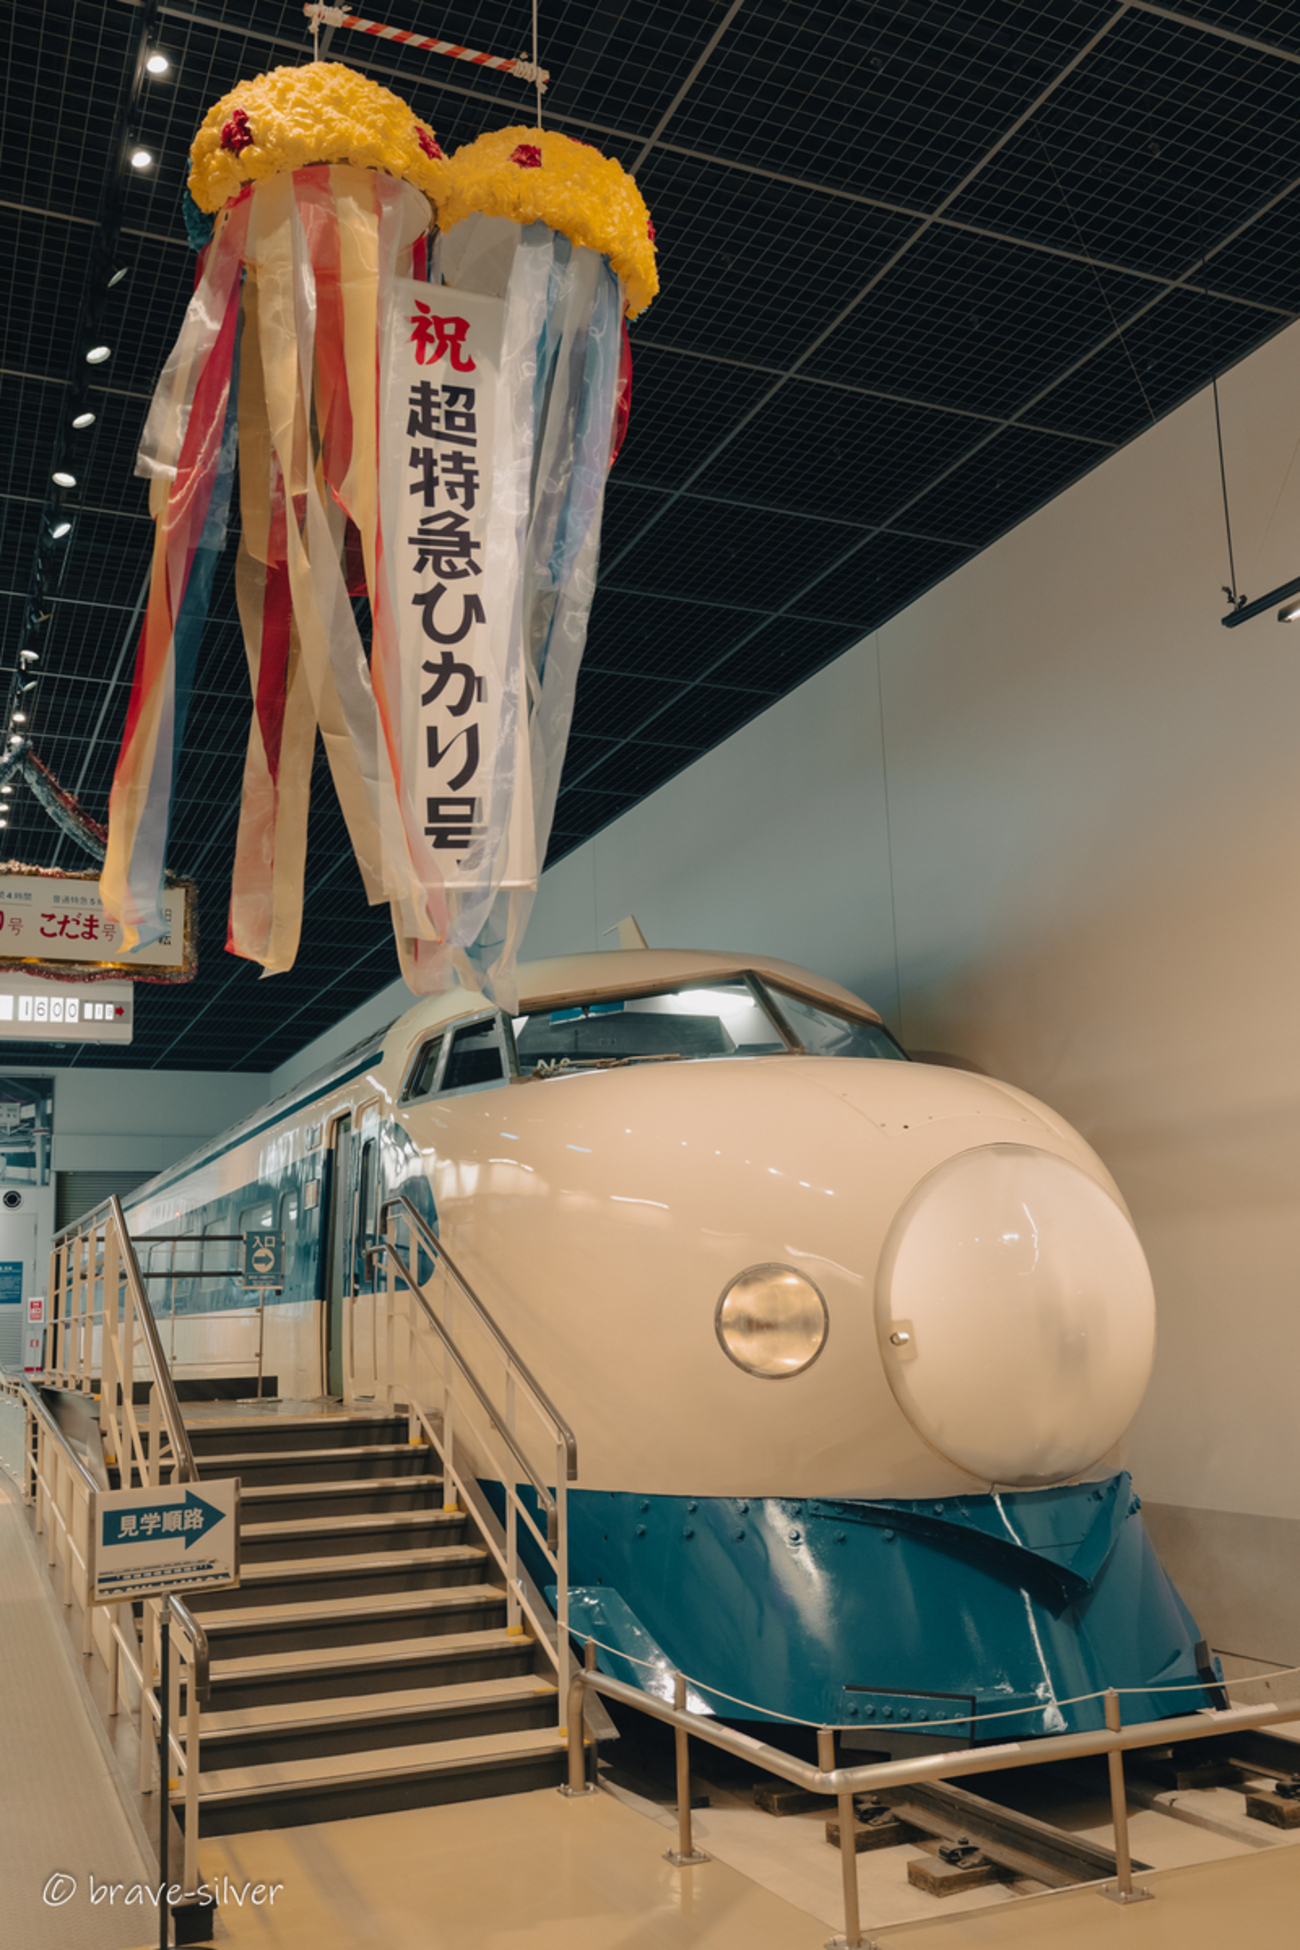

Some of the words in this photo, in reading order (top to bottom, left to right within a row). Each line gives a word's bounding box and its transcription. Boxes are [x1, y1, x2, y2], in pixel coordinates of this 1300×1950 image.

[404, 299, 477, 373] 祝
[406, 380, 488, 871] 超特急ひかり号
[39, 912, 117, 943] こだま号
[24, 1000, 77, 1018] 1600
[252, 1236, 275, 1248] 入口
[117, 1507, 204, 1539] 見学順路
